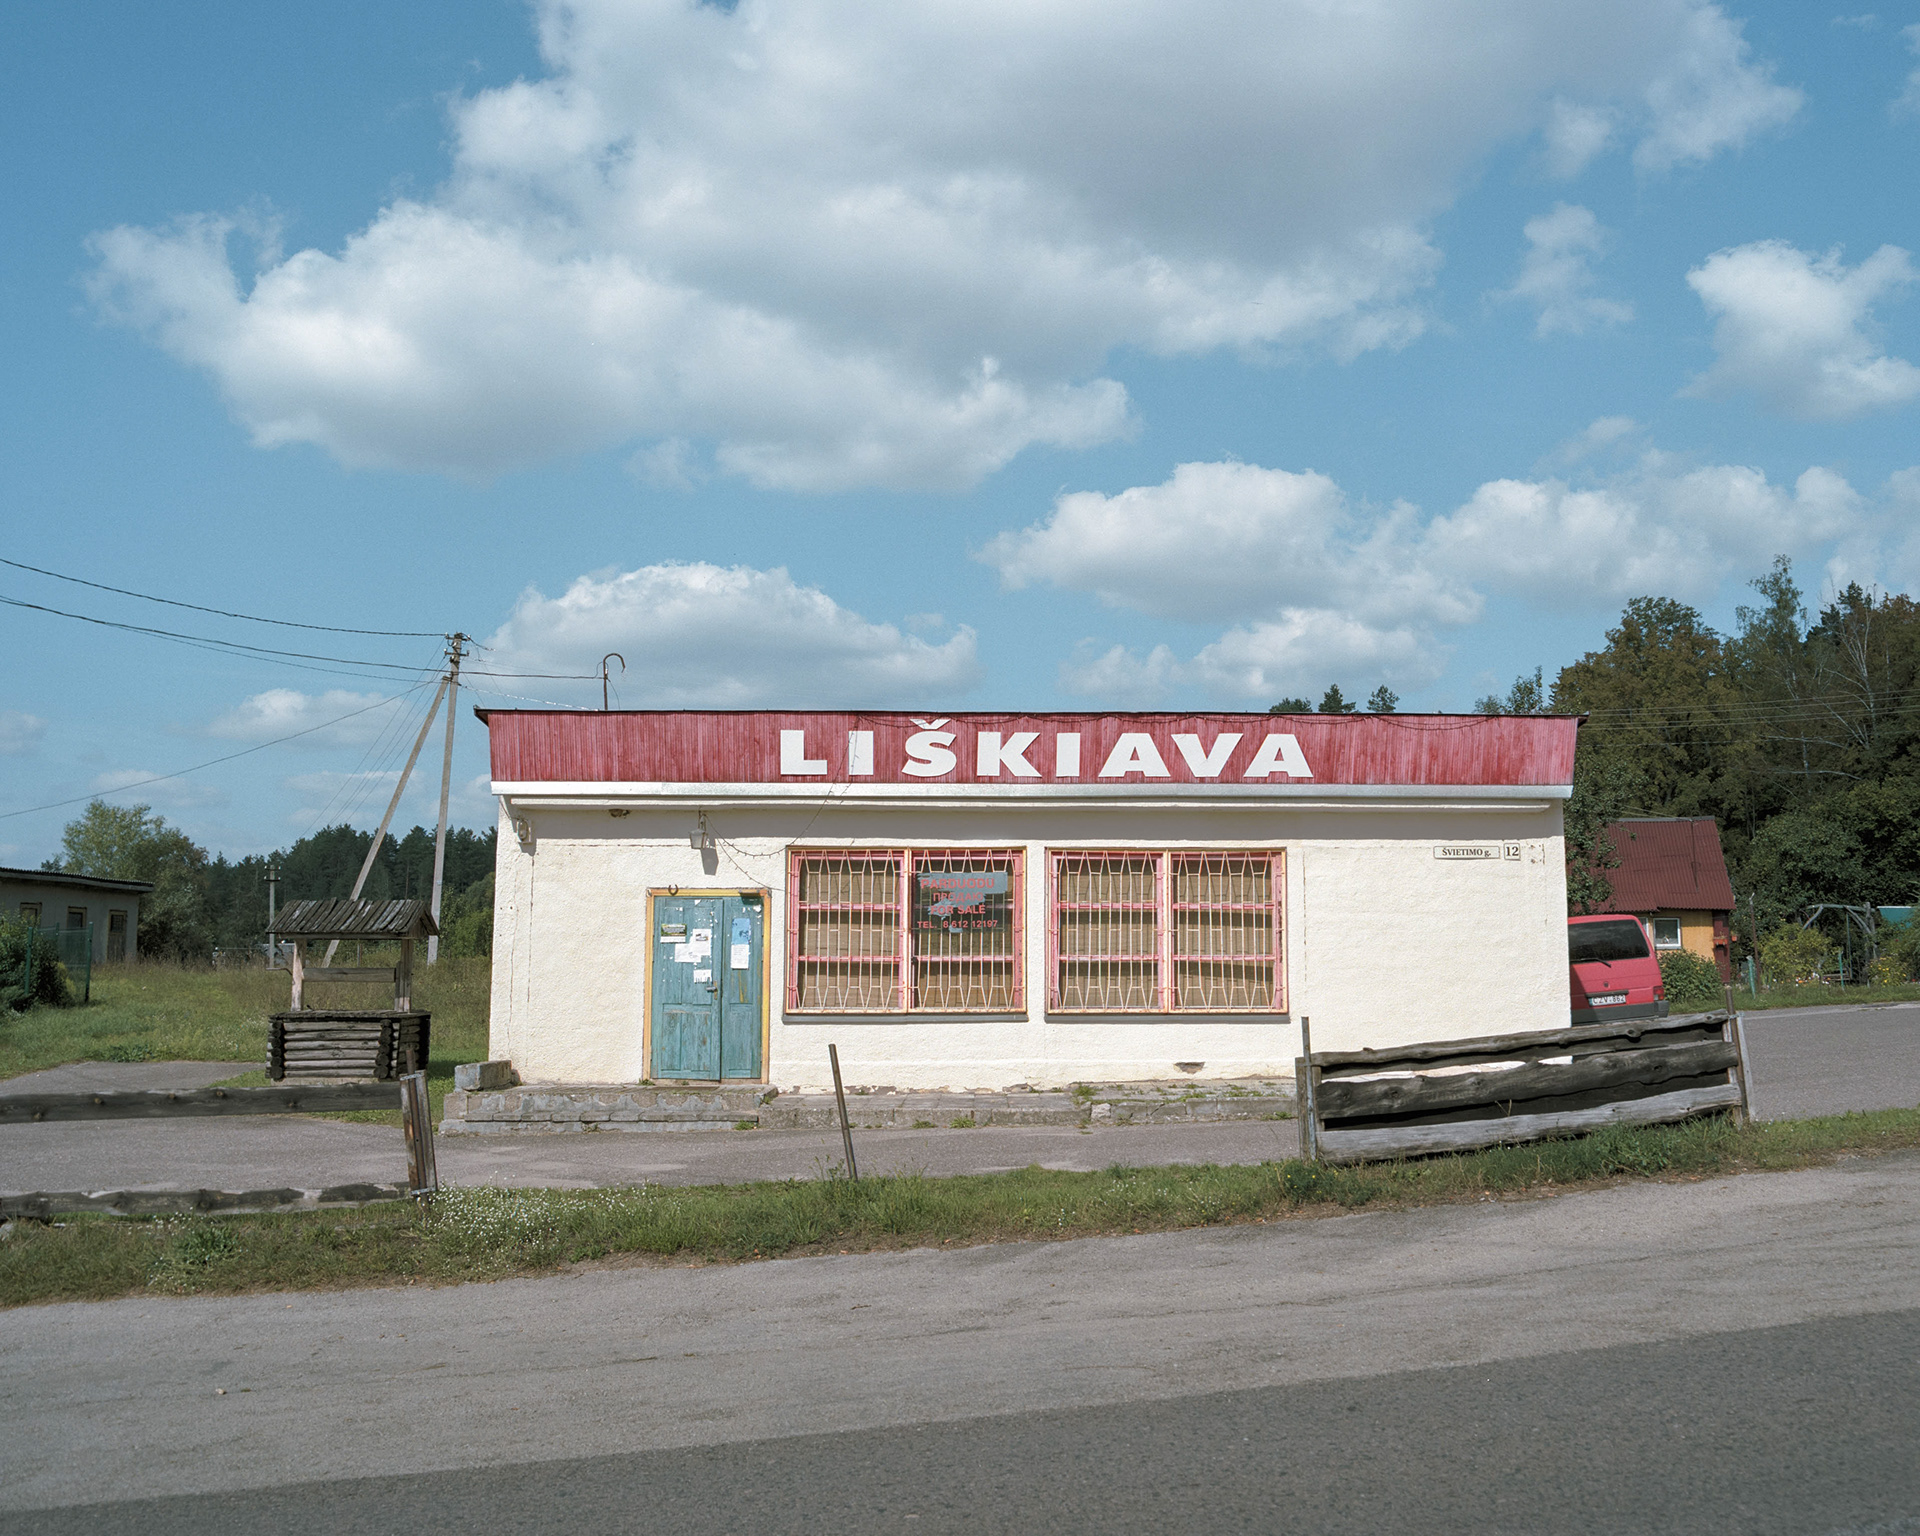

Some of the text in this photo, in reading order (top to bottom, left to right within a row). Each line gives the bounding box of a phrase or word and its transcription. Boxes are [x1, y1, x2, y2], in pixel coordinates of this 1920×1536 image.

[780, 718, 1314, 778] LIŠKIAVA
[1442, 847, 1483, 856] ŠVIETIMO
[1506, 846, 1519, 856] 12
[920, 878, 995, 889] PARDUODU
[933, 892, 984, 903] ПРОДАЮ
[930, 905, 986, 915] FOR SALE
[917, 920, 937, 929] TEL.
[951, 920, 969, 928] 612
